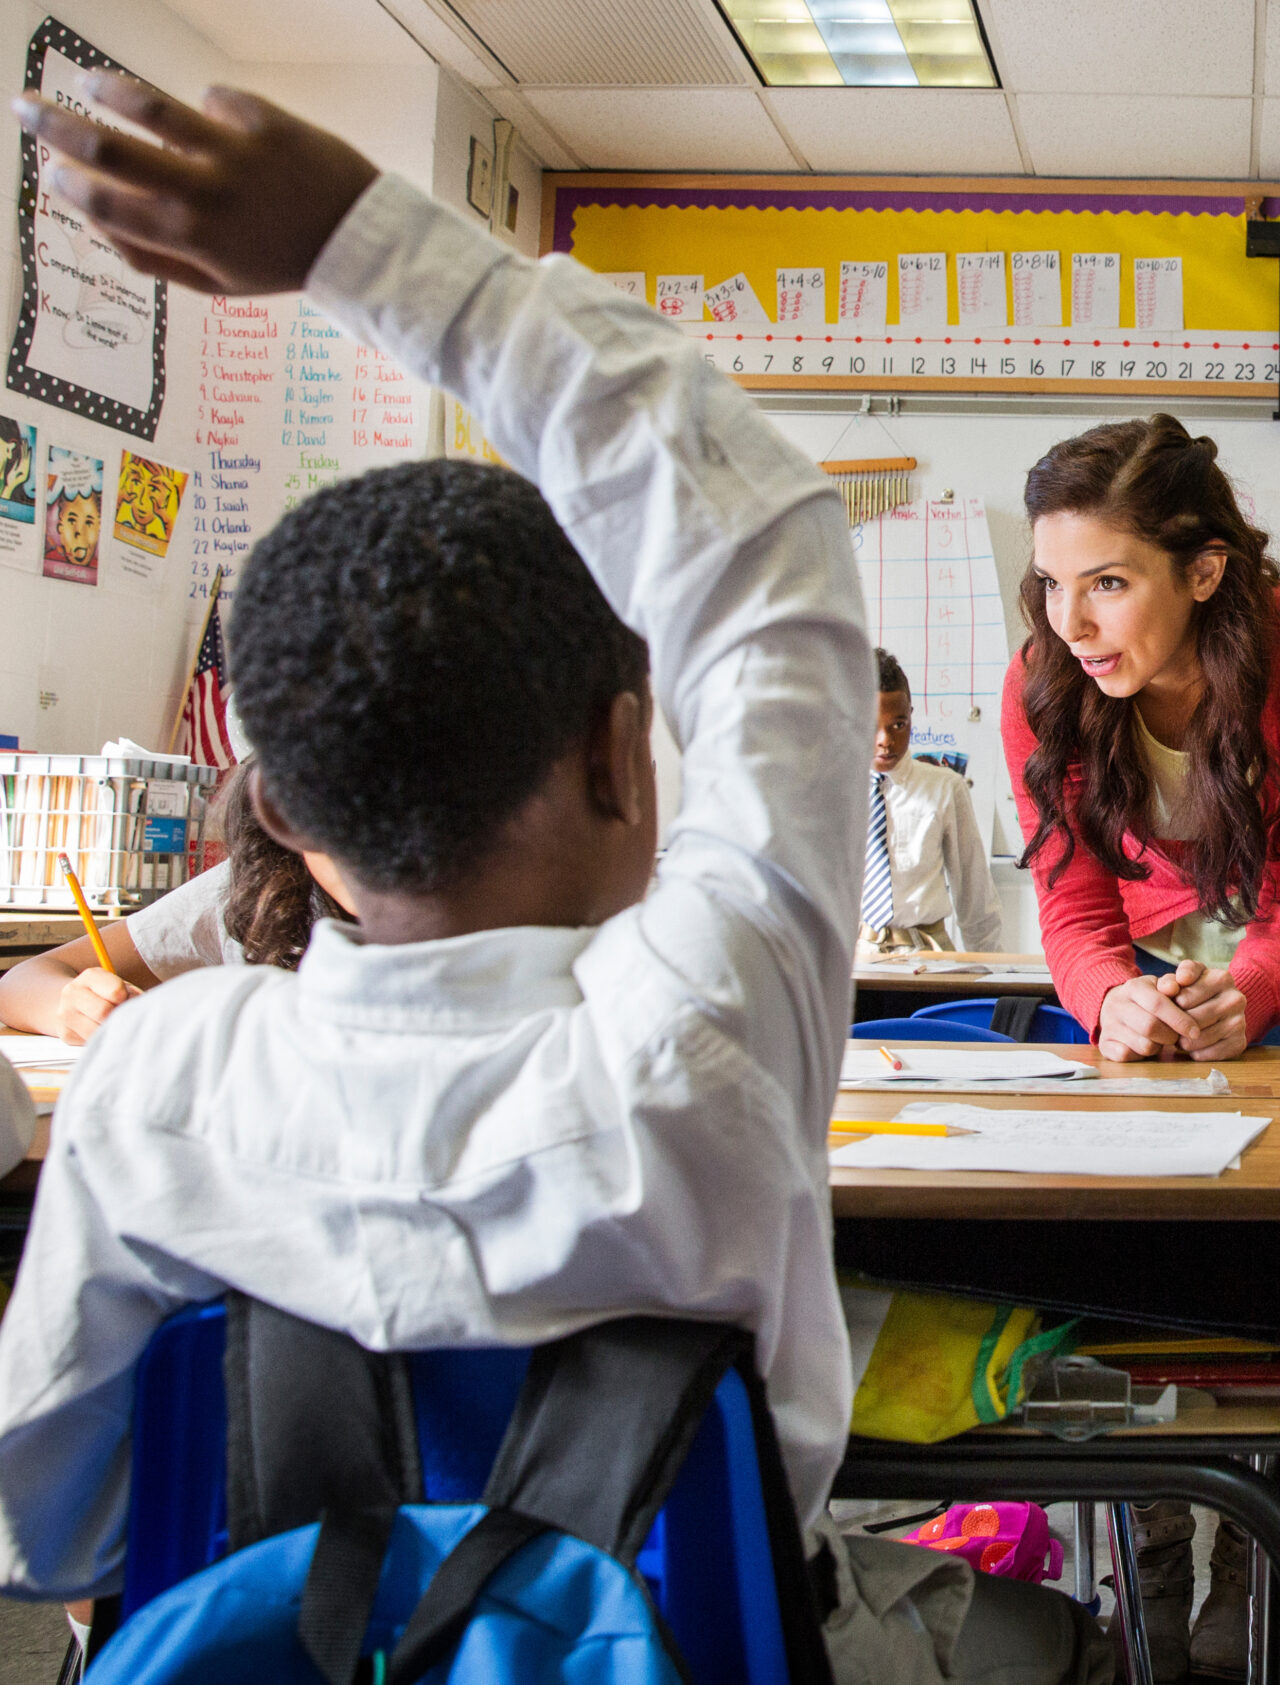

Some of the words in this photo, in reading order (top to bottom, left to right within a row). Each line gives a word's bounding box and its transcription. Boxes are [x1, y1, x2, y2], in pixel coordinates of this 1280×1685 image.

[211, 295, 269, 323] Monday
[733, 355, 743, 372] 6
[764, 355, 774, 372] 7
[792, 355, 804, 373] 8
[822, 355, 834, 373] 9
[850, 357, 866, 374] 10
[883, 357, 893, 375] 11
[910, 357, 927, 375] 12
[941, 358, 956, 375] 13
[970, 358, 987, 375] 14
[1000, 358, 1017, 376] 15
[1030, 359, 1046, 377] 16
[1061, 359, 1076, 377] 17
[1091, 360, 1107, 378] 18
[1119, 360, 1136, 377] 19
[1146, 361, 1168, 379] 20
[1178, 362, 1193, 379] 21
[1205, 362, 1226, 381] 22
[1235, 362, 1256, 381] 23
[209, 450, 262, 473] Thursday
